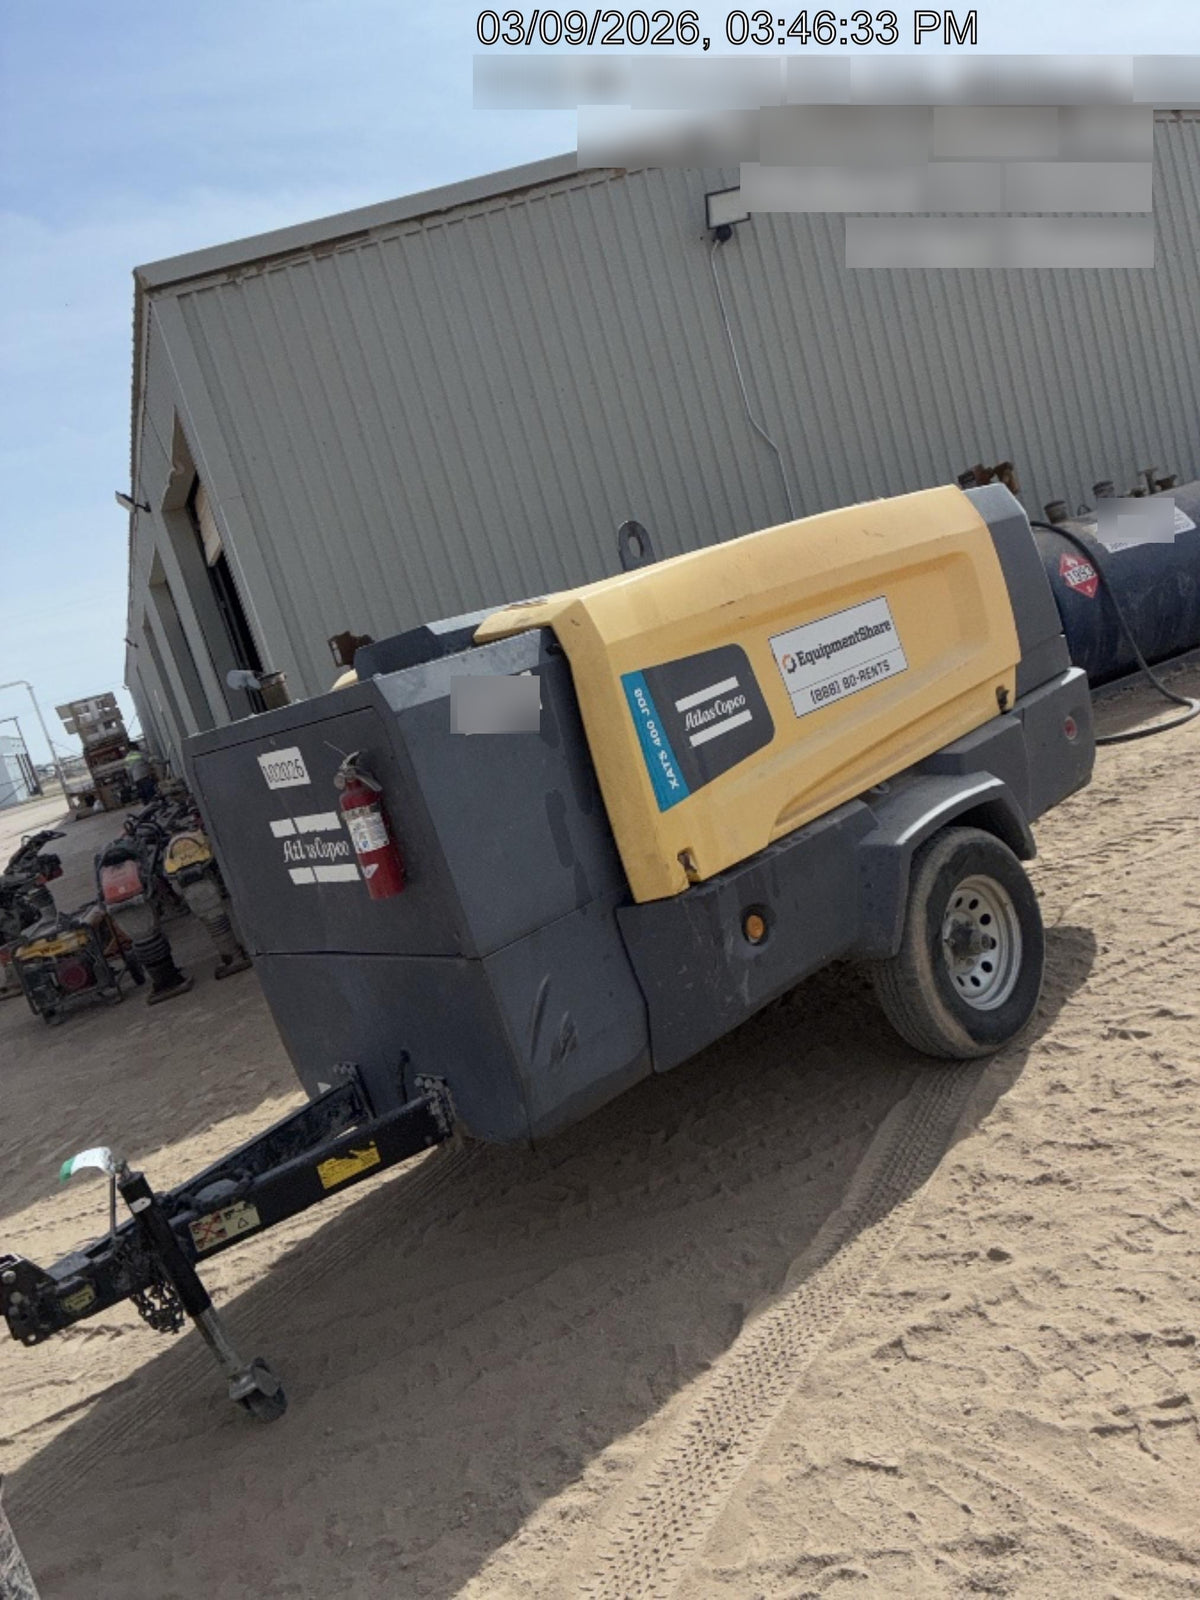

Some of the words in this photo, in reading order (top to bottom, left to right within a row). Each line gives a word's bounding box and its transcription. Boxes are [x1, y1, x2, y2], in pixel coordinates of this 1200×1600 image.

[795, 620, 892, 667] EquipmentShare
[634, 688, 650, 716] JD8
[810, 680, 841, 704] (888)
[647, 720, 661, 747] 400
[659, 749, 680, 790] XATS
